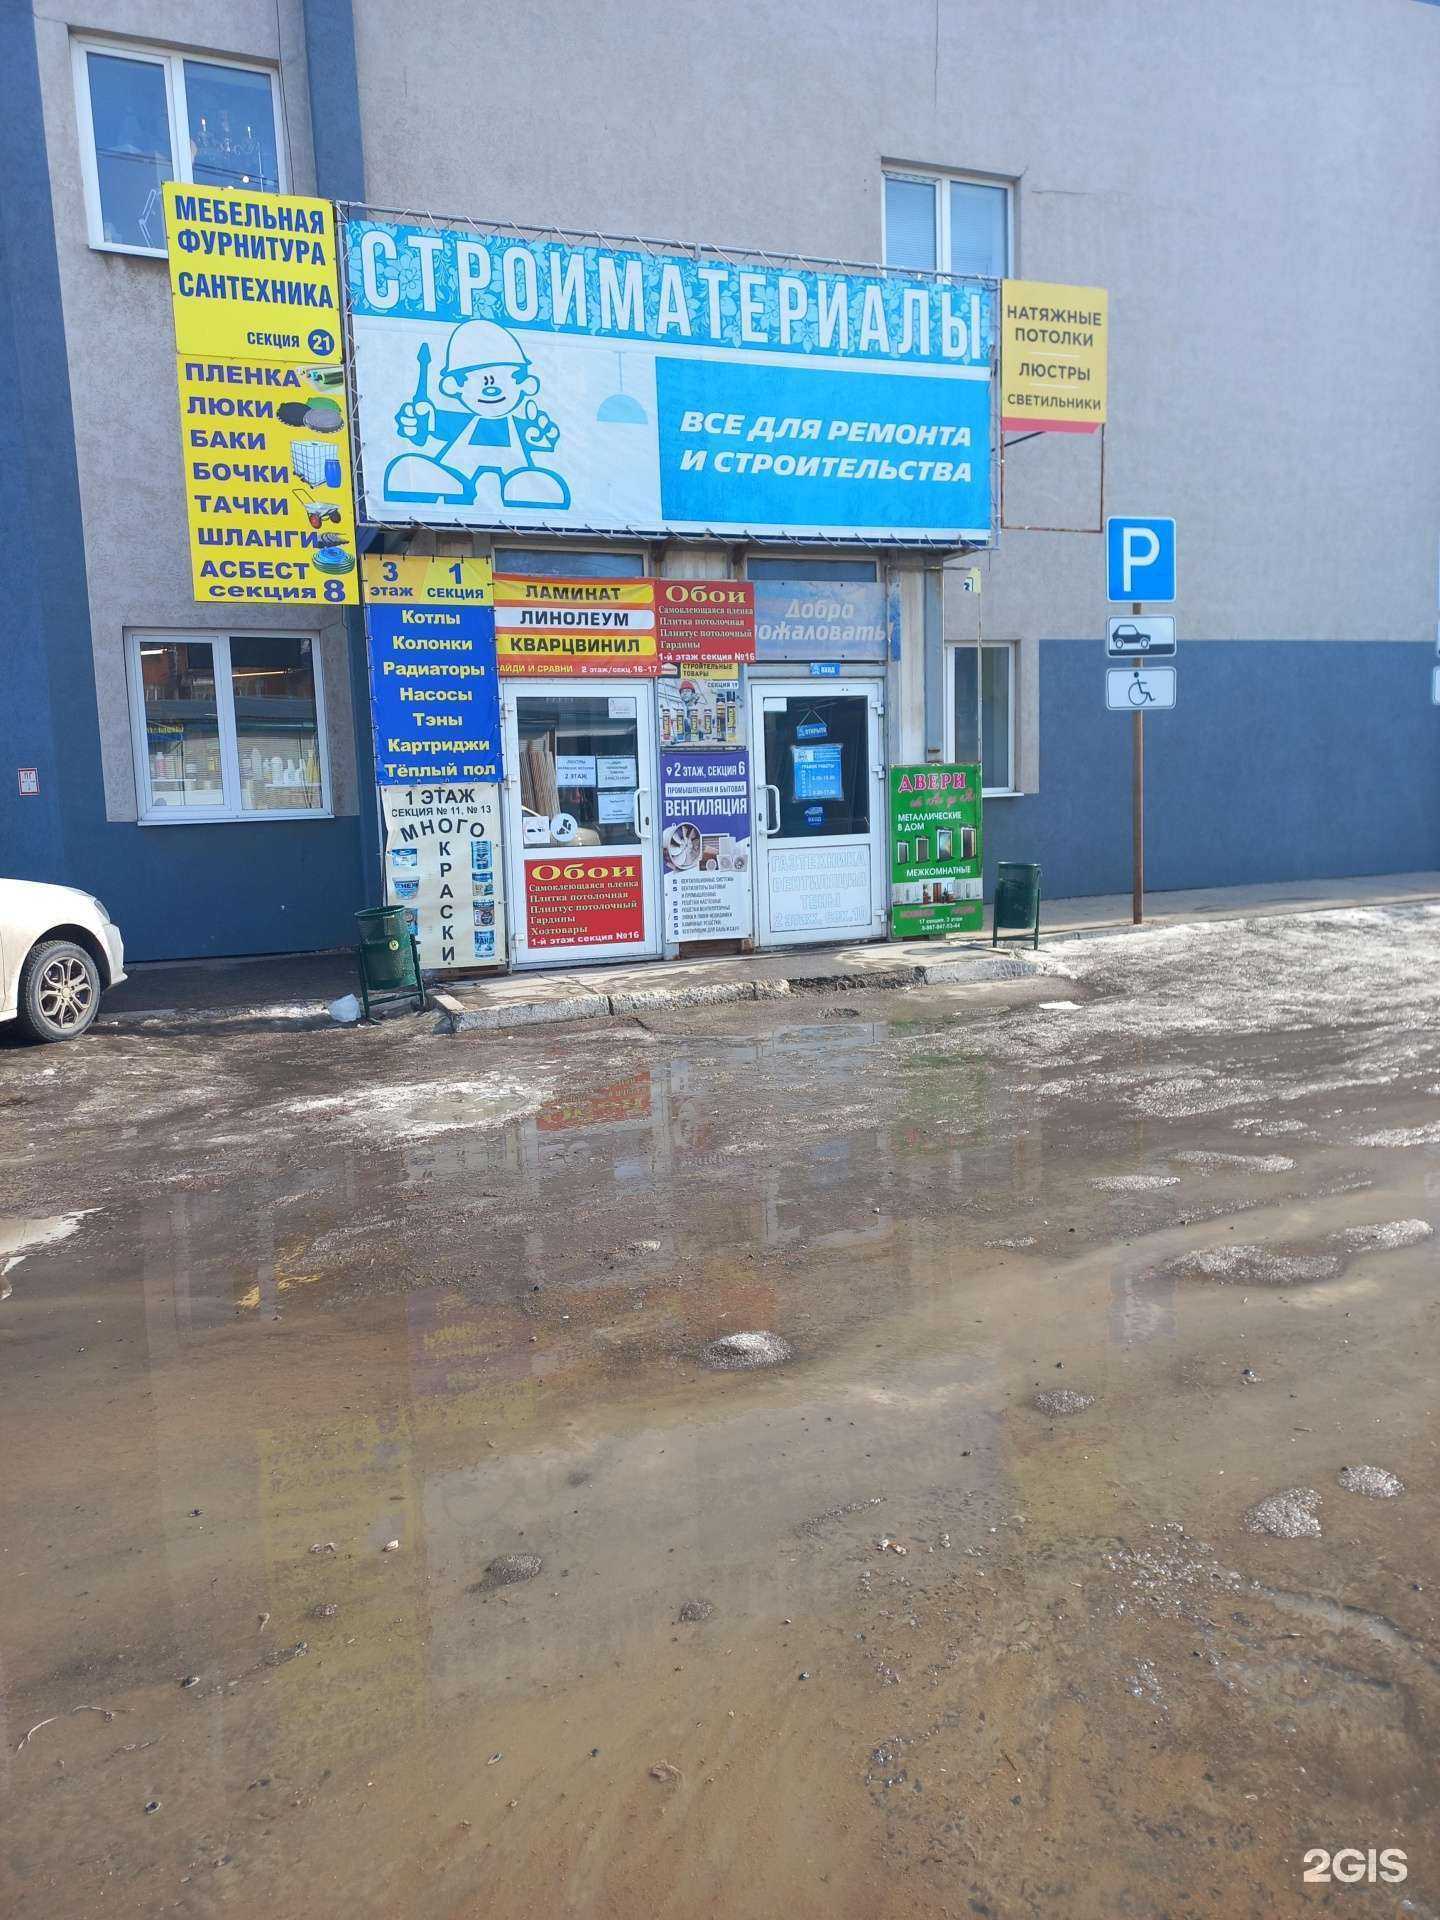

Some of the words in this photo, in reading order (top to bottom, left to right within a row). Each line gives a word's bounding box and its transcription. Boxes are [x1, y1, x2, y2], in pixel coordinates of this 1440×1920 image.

[175, 195, 325, 234] МЕБЕЛЬНАЯ
[177, 229, 326, 266] ФУРНИТУРА
[178, 272, 333, 309] САНТЕХНИКА
[1007, 304, 1102, 326] НАТЯЖНЫЕ
[247, 332, 300, 349] СЕКЦИЯ
[312, 334, 330, 351] 21
[1015, 328, 1093, 347] ПОТОЛКИ
[185, 363, 301, 387] ПЛЕНКА
[1019, 363, 1090, 381] ЛЮСТРЫ
[187, 396, 274, 419] ЛЮКИ
[1007, 393, 1101, 410] СВЕТИЛЬНИКИ
[680, 411, 745, 435] ВСЕ
[747, 416, 822, 442] ДЛЯ
[828, 420, 972, 447] РЕМОНТА
[190, 429, 266, 450] БАКИ
[193, 462, 289, 483] БОЧКИ
[680, 449, 708, 471] И
[713, 451, 972, 482] СТРОИТЕЛЬСТВА
[194, 494, 288, 515] ТАЧКИ
[198, 528, 318, 549] ШЛАНГИ
[200, 560, 309, 579] АСБЕСТ
[382, 562, 398, 582] 3
[448, 563, 463, 585] 1
[209, 585, 317, 601] секция
[323, 579, 346, 602] 8
[370, 586, 413, 597] этаж
[427, 587, 484, 599] СЕКЦИЯ
[525, 585, 620, 600] ЛАМИНАТ
[665, 585, 746, 603] Обои
[402, 609, 461, 625] Котлы
[785, 598, 854, 622] Добро
[520, 611, 629, 627] ЛИНОЛЕУМ
[660, 617, 693, 625] Плитка
[392, 635, 473, 650] Колонки
[660, 629, 699, 639] Плинтус
[700, 629, 752, 637] потолочный
[510, 637, 640, 655] КВАРЦВИНИЛ
[661, 640, 700, 650] Гардины
[659, 652, 673, 660] 1-й
[701, 653, 732, 662] секция
[734, 652, 755, 660] №16
[383, 661, 485, 678] Радиаторы
[538, 665, 573, 673] СРАВНИ
[400, 688, 473, 701] Насосы
[412, 712, 463, 726] Тэны
[388, 738, 490, 755] Картриджи
[383, 762, 457, 778] Тёплый
[463, 764, 496, 776] пол
[674, 762, 681, 776] 2
[682, 766, 706, 778] ЭТАЖ,
[708, 765, 737, 777] СЕКЦИЯ
[738, 761, 745, 775] 6
[667, 786, 713, 795] ПРОМЫШЛЕННАЯ
[720, 785, 745, 793] БЫТОВАЯ
[897, 772, 967, 793] ДВЕРИ
[405, 791, 413, 805] 1
[421, 788, 475, 804] ЭТАЖ
[392, 807, 433, 818] СЕКЦИЯ
[481, 805, 492, 814] 13
[665, 798, 748, 816] ВЕНТИЛЯЦИЯ
[898, 811, 962, 822] МЕТАЛЛИЧЕСКИЕ
[400, 818, 485, 842] МНОГО
[898, 823, 903, 831] В
[904, 822, 925, 832] ДОМ
[532, 863, 636, 881] Обои
[906, 865, 972, 877] МЕЖКОМНАТНЫЕ
[529, 883, 605, 892] Самоклеющаяся
[607, 880, 639, 888] пленка
[530, 894, 567, 903] Плитка
[570, 892, 628, 901] потолочная
[530, 904, 573, 914] Плинтус
[576, 901, 637, 911] потолочный
[530, 916, 576, 925] Гардины
[531, 926, 588, 935] Хозтовары
[532, 937, 546, 945] 1-й
[550, 937, 575, 945] этаж
[578, 934, 613, 943] секция
[616, 931, 640, 940] №16
